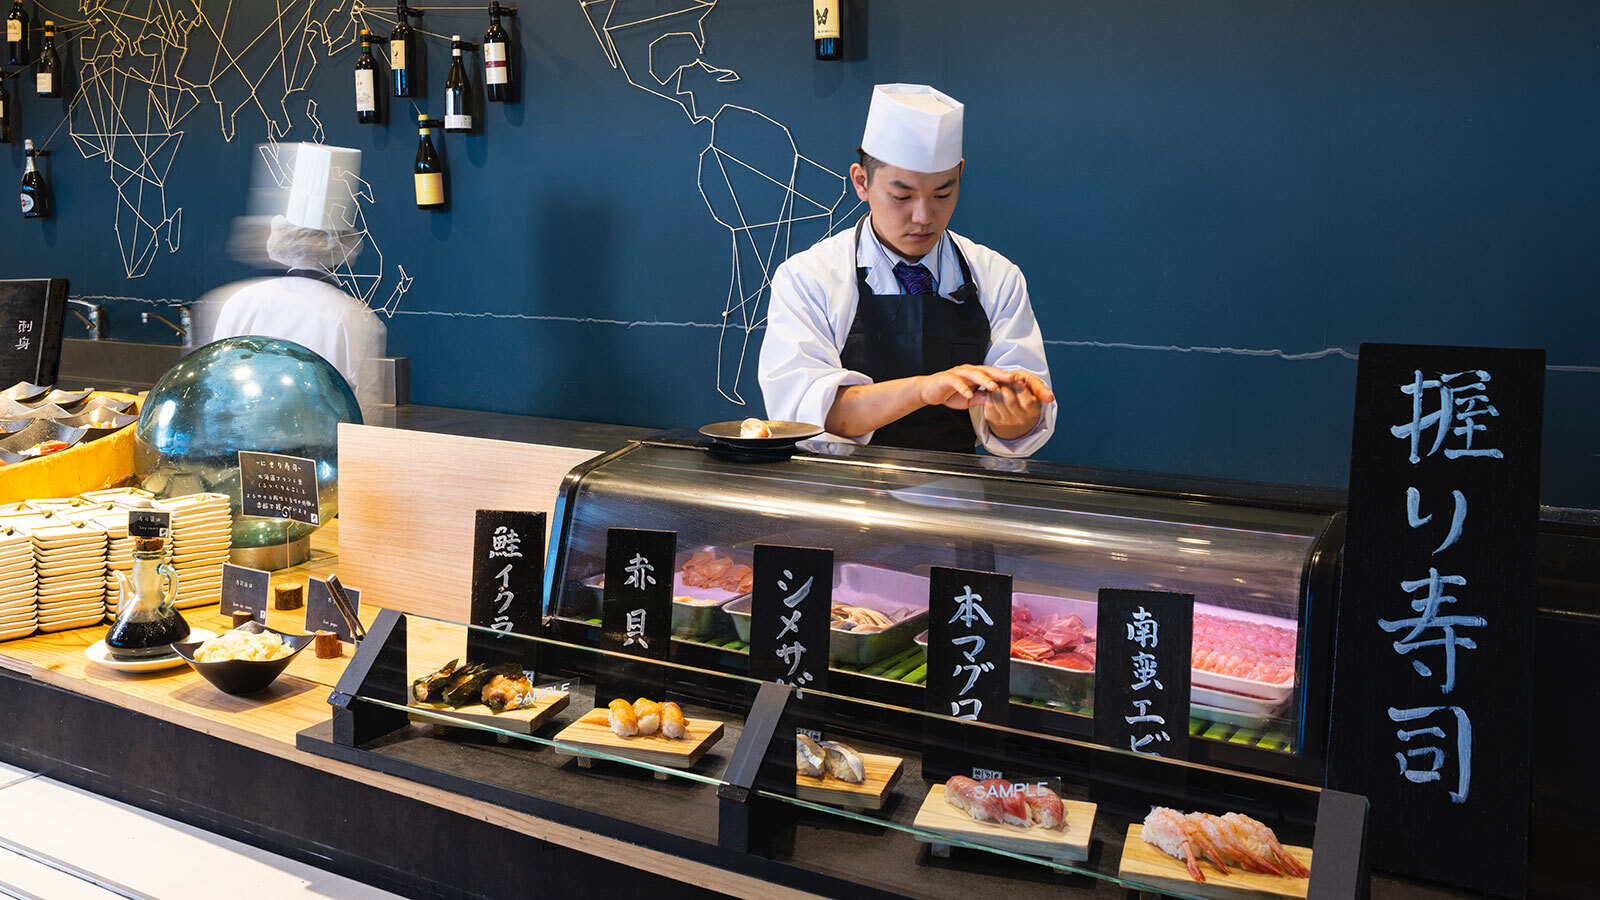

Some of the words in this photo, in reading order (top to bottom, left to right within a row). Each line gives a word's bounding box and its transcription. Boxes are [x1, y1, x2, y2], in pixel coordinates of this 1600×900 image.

[15, 320, 33, 351] 刺身
[488, 525, 523, 639] 鮭イクラ
[622, 552, 657, 650] 赤貝
[1376, 368, 1505, 804] 握り寿司
[513, 682, 571, 705] SAMPLE
[947, 584, 996, 724] 本マグロ
[1124, 605, 1171, 758] 南蛮エビ
[973, 781, 1049, 800] SAMPLE
